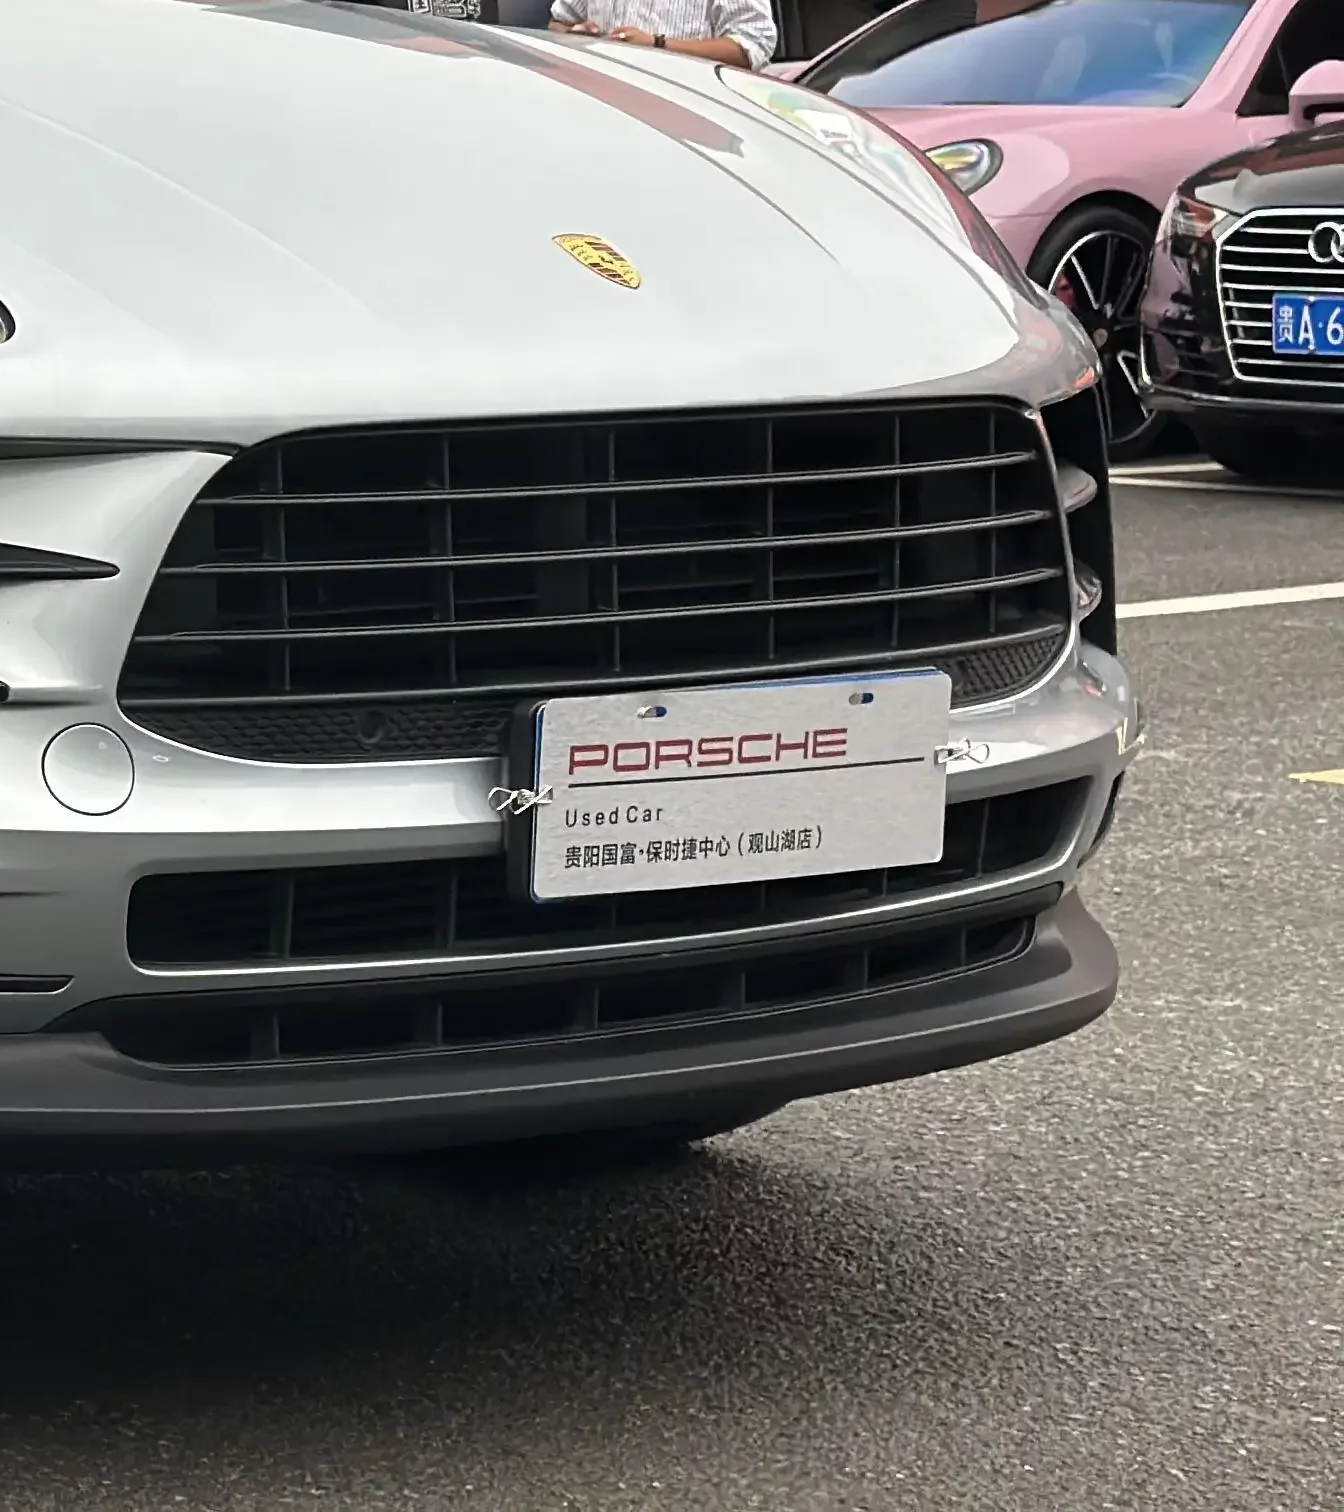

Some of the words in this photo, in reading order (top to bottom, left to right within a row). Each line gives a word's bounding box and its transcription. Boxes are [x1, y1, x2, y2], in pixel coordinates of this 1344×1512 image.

[568, 727, 848, 776] PORSCHE
[565, 806, 619, 828] Used
[625, 805, 664, 824] Car
